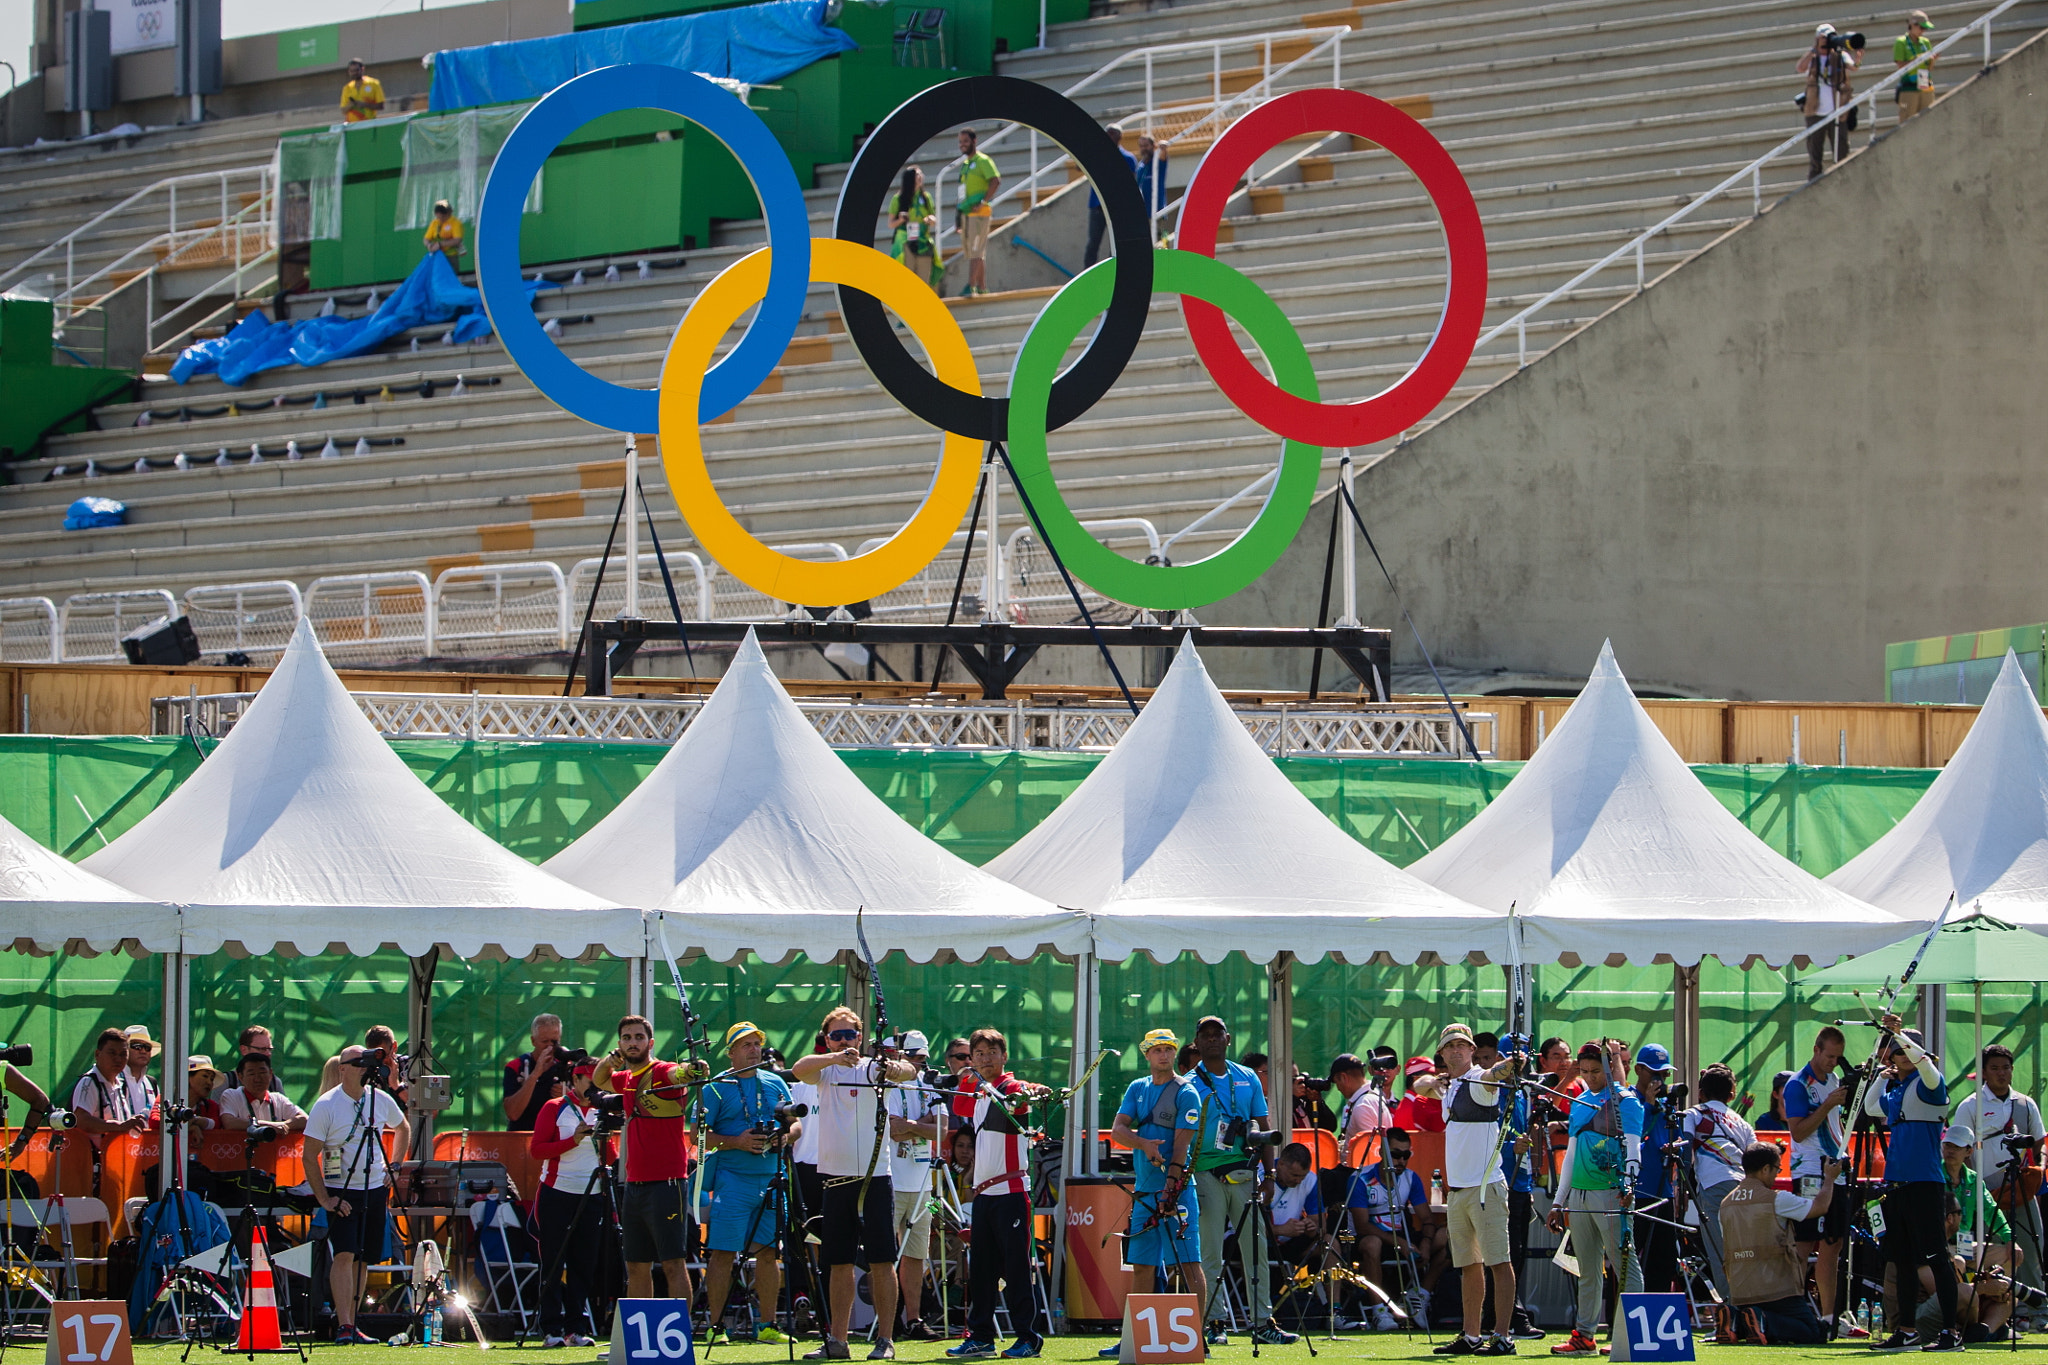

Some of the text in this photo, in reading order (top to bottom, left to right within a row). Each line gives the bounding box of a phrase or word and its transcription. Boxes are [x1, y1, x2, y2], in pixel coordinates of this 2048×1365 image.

[639, 1094, 659, 1112] ESP
[128, 1144, 160, 1158] Rio2
[1731, 1188, 1754, 1201] 1231
[1066, 1205, 1095, 1226] 2016
[1734, 1249, 1755, 1260] PHOTO
[62, 1313, 123, 1362] 17
[626, 1311, 688, 1359] 16
[1136, 1306, 1198, 1353] 15
[1628, 1305, 1688, 1351] 14
